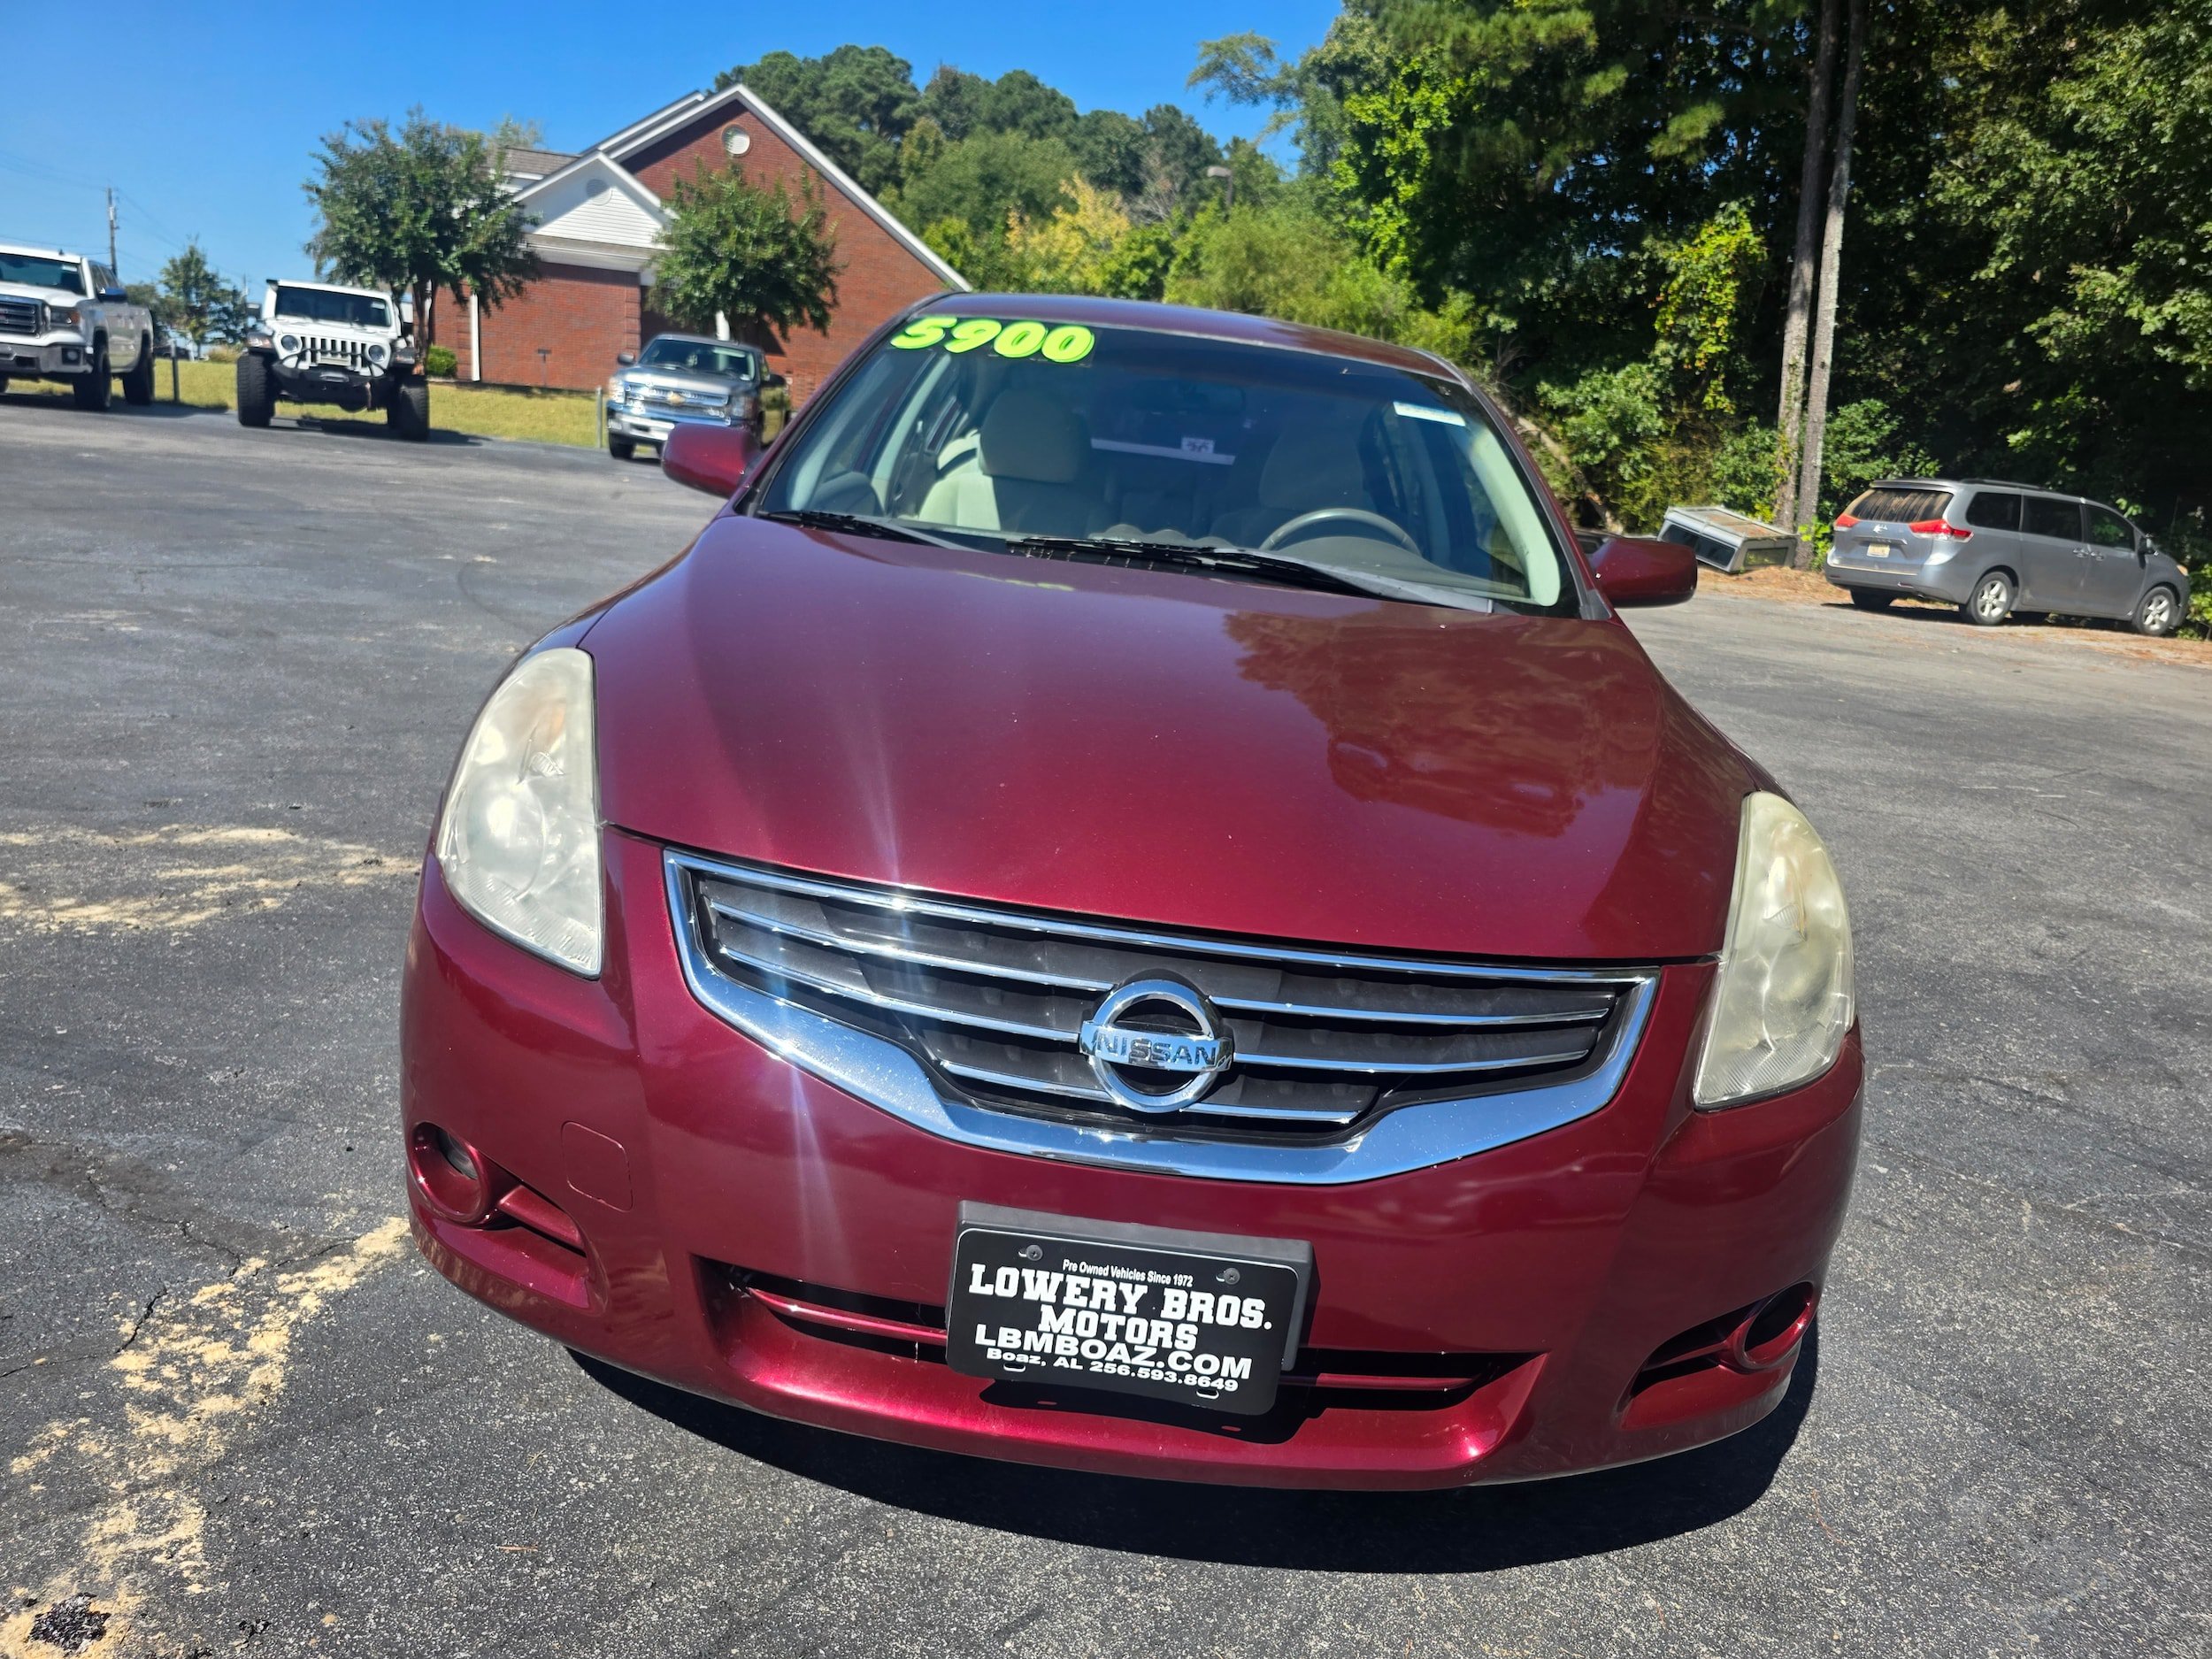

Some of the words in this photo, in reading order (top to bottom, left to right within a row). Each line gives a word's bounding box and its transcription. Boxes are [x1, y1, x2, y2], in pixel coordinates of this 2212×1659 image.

[890, 317, 1094, 364] 5900
[1097, 1033, 1217, 1066] NISSAN
[1062, 1258, 1078, 1272] Pre
[1079, 1261, 1109, 1277] Owned
[1110, 1265, 1146, 1282] Vehicles
[1147, 1270, 1171, 1285] Since
[1172, 1273, 1194, 1287] 1972
[969, 1263, 1148, 1315] LOWERY
[1160, 1287, 1272, 1330] BROS.
[1038, 1303, 1199, 1352] MOTORS
[975, 1323, 1253, 1380] LBMBOAZ.COM
[986, 1347, 1047, 1367] Boaz,
[1053, 1356, 1084, 1371] AL
[1088, 1361, 1239, 1393] 256.593.8649
